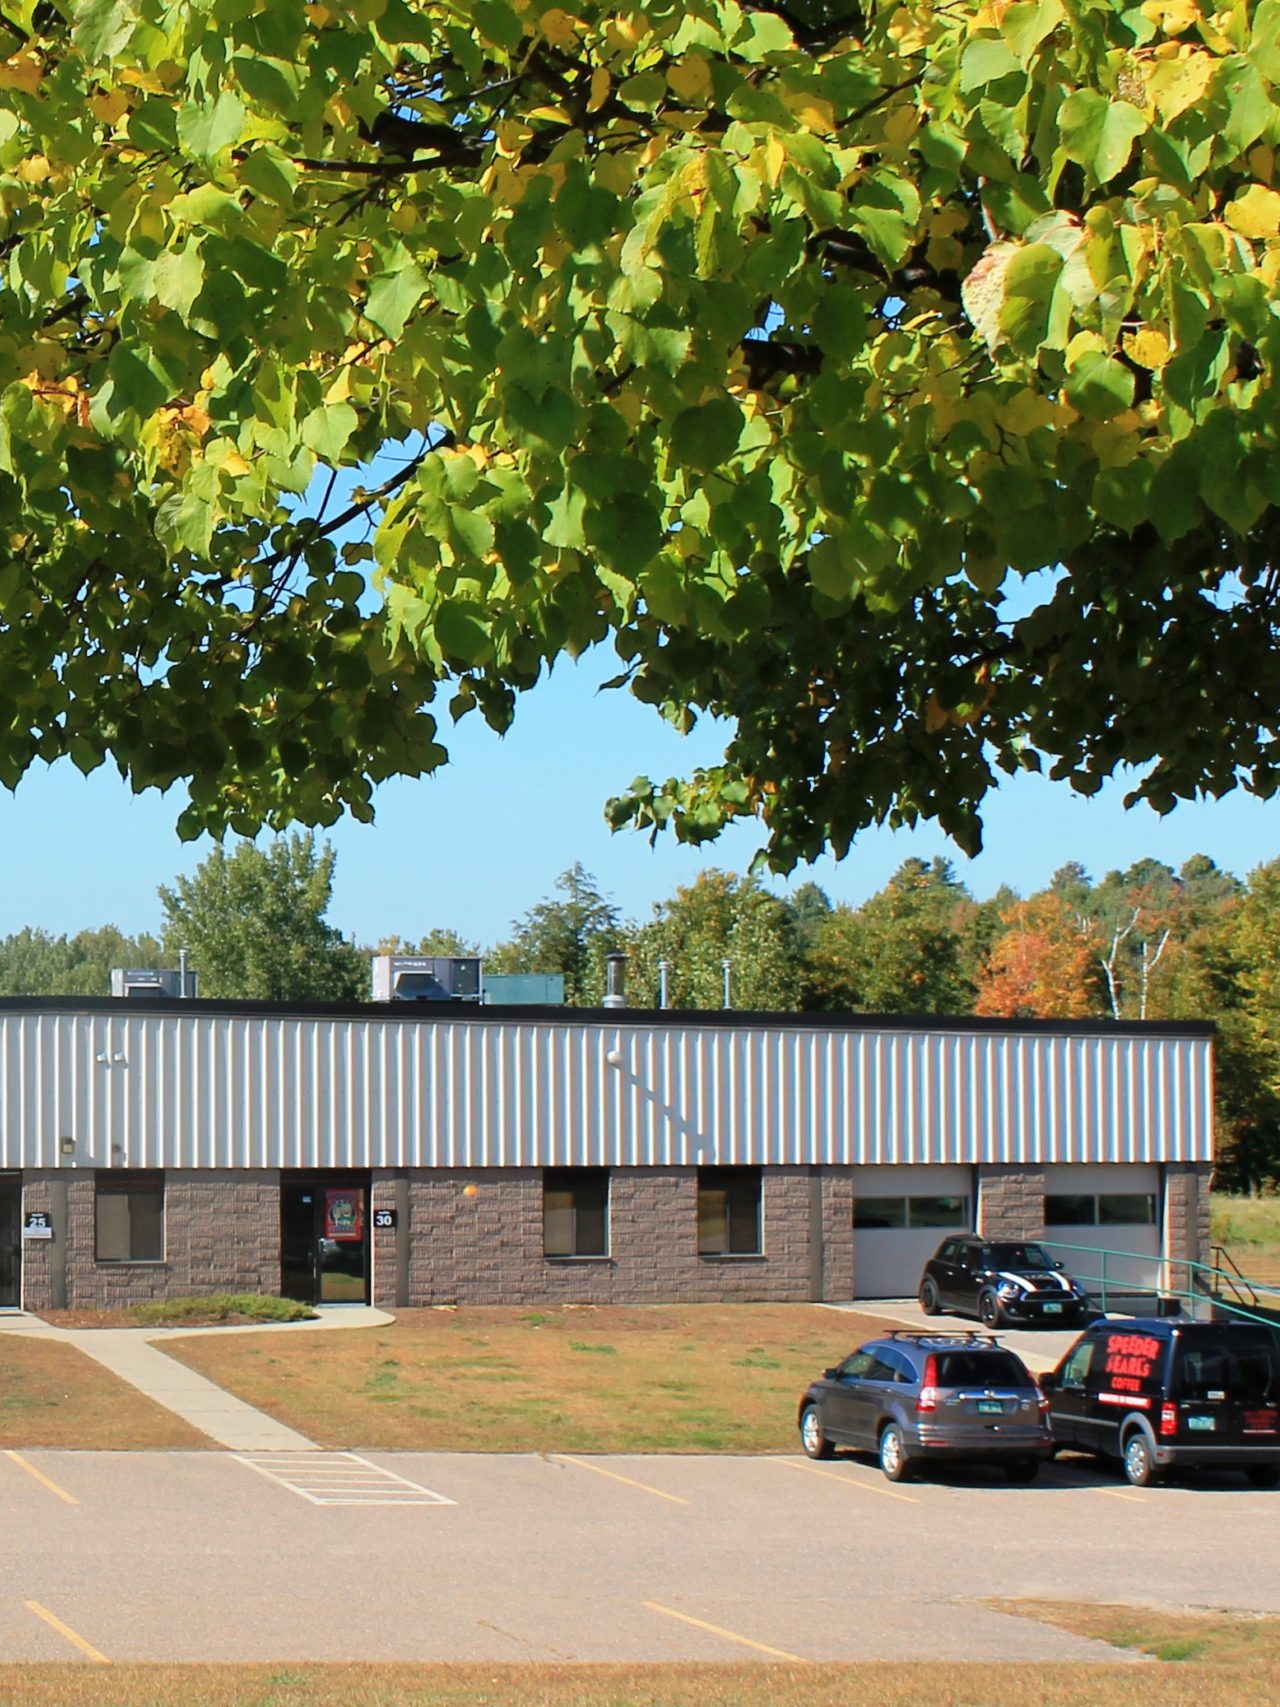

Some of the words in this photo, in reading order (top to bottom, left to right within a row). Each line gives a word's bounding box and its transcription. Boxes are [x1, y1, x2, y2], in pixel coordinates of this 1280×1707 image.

[29, 1217, 46, 1229] 25
[376, 1215, 393, 1226] 30
[1106, 1334, 1160, 1359] SPEEDER
[1112, 1376, 1141, 1392] COFFEE
